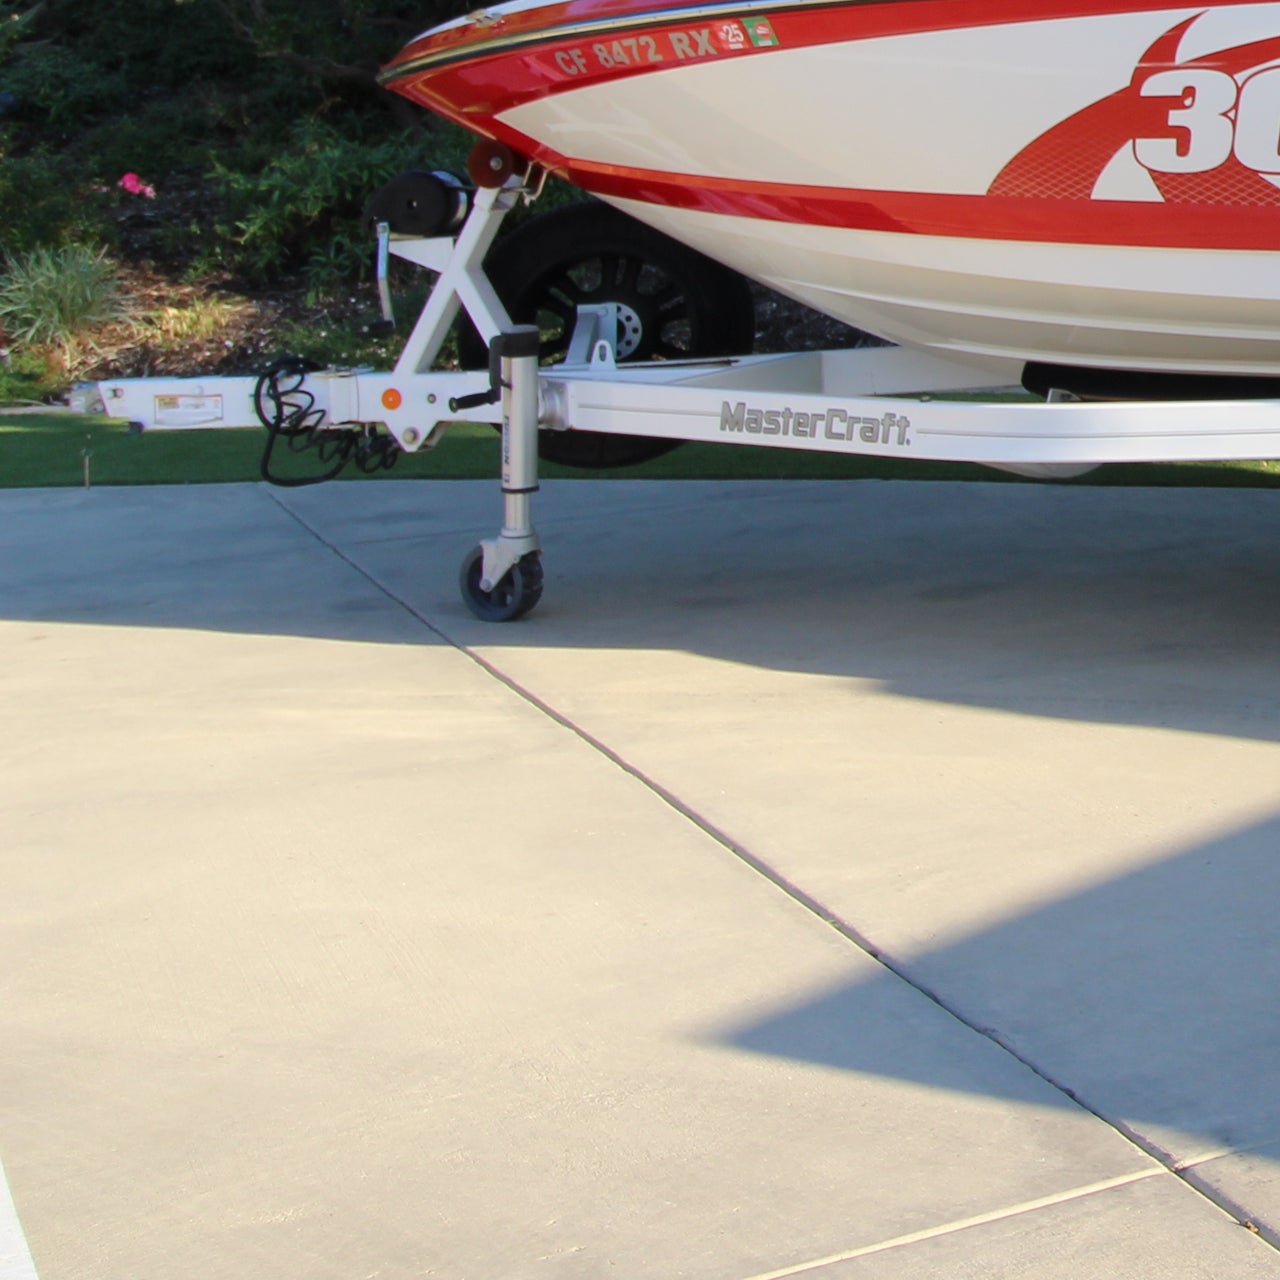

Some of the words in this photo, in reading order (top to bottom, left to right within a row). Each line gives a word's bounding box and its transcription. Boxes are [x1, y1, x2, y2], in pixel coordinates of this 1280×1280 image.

[722, 24, 744, 42] 25
[555, 49, 587, 75] CF
[593, 35, 662, 68] 8472
[668, 28, 717, 60] RX
